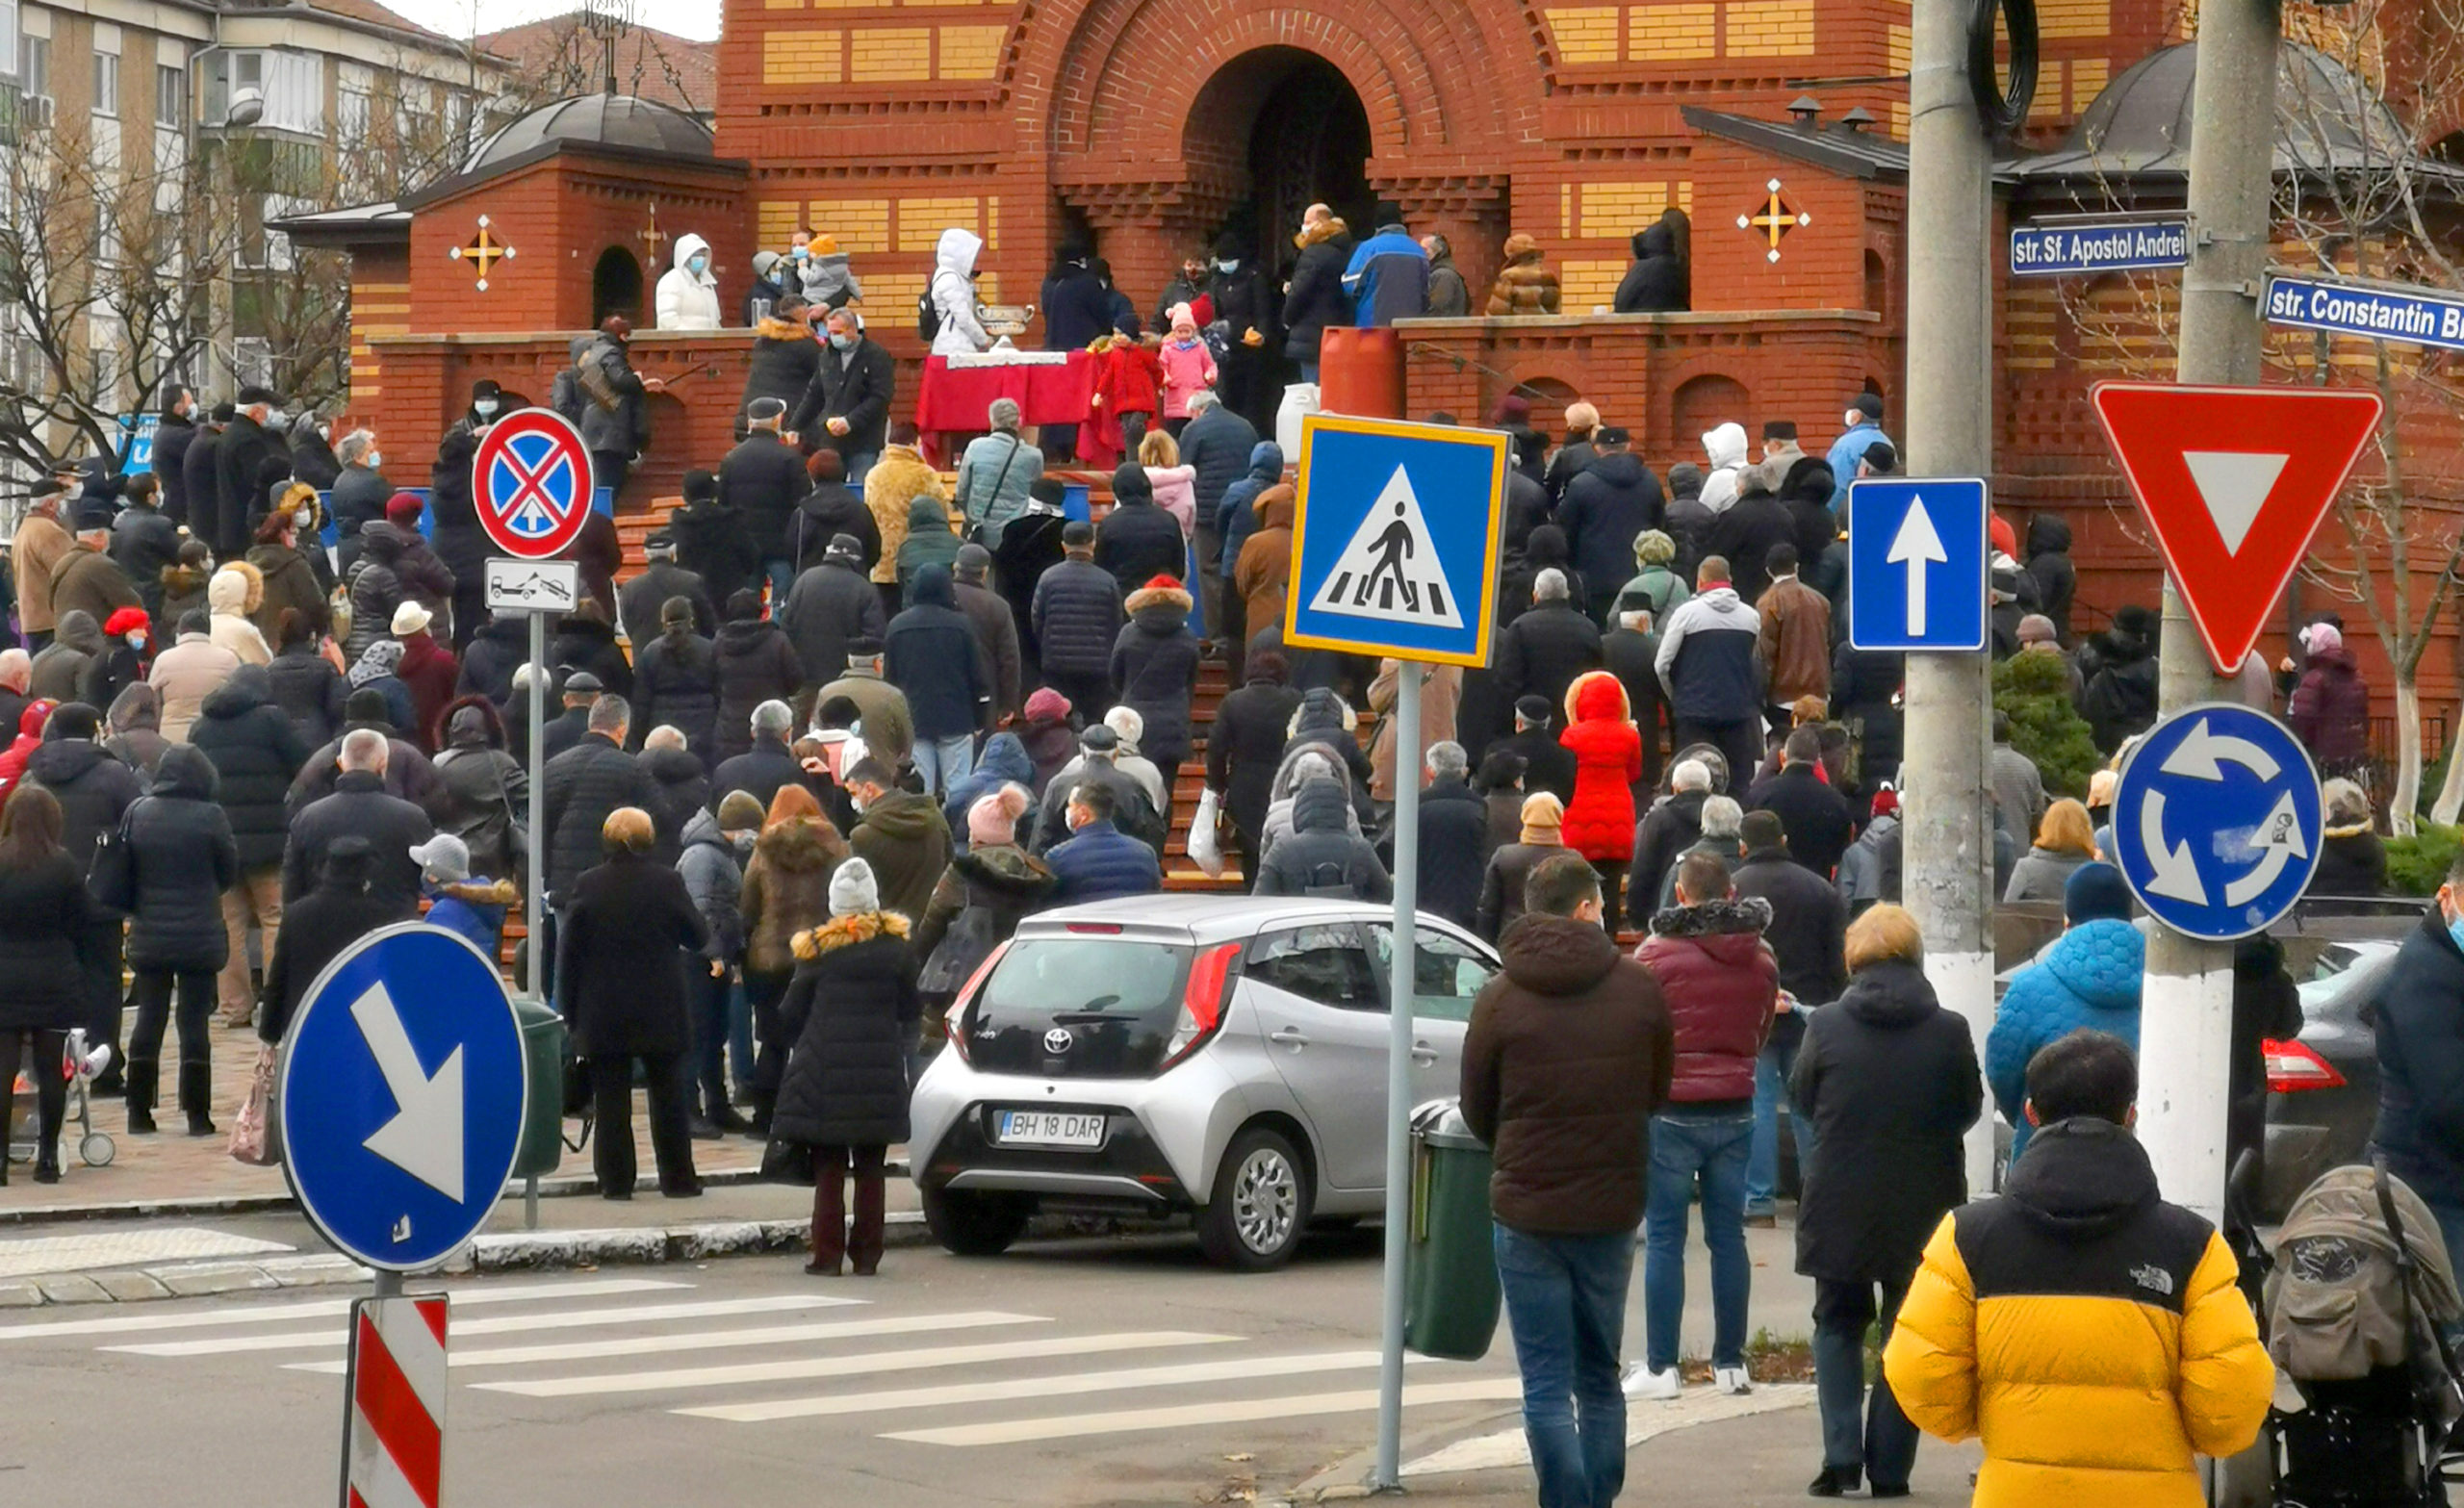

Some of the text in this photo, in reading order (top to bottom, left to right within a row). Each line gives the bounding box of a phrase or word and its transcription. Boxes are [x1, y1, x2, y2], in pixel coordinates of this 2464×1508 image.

[2015, 228, 2185, 268] str. Sf. Apostol Andrei
[2272, 288, 2305, 319] str.
[2311, 290, 2436, 336] Constantin
[1012, 1115, 1101, 1138] BH 18 DAR
